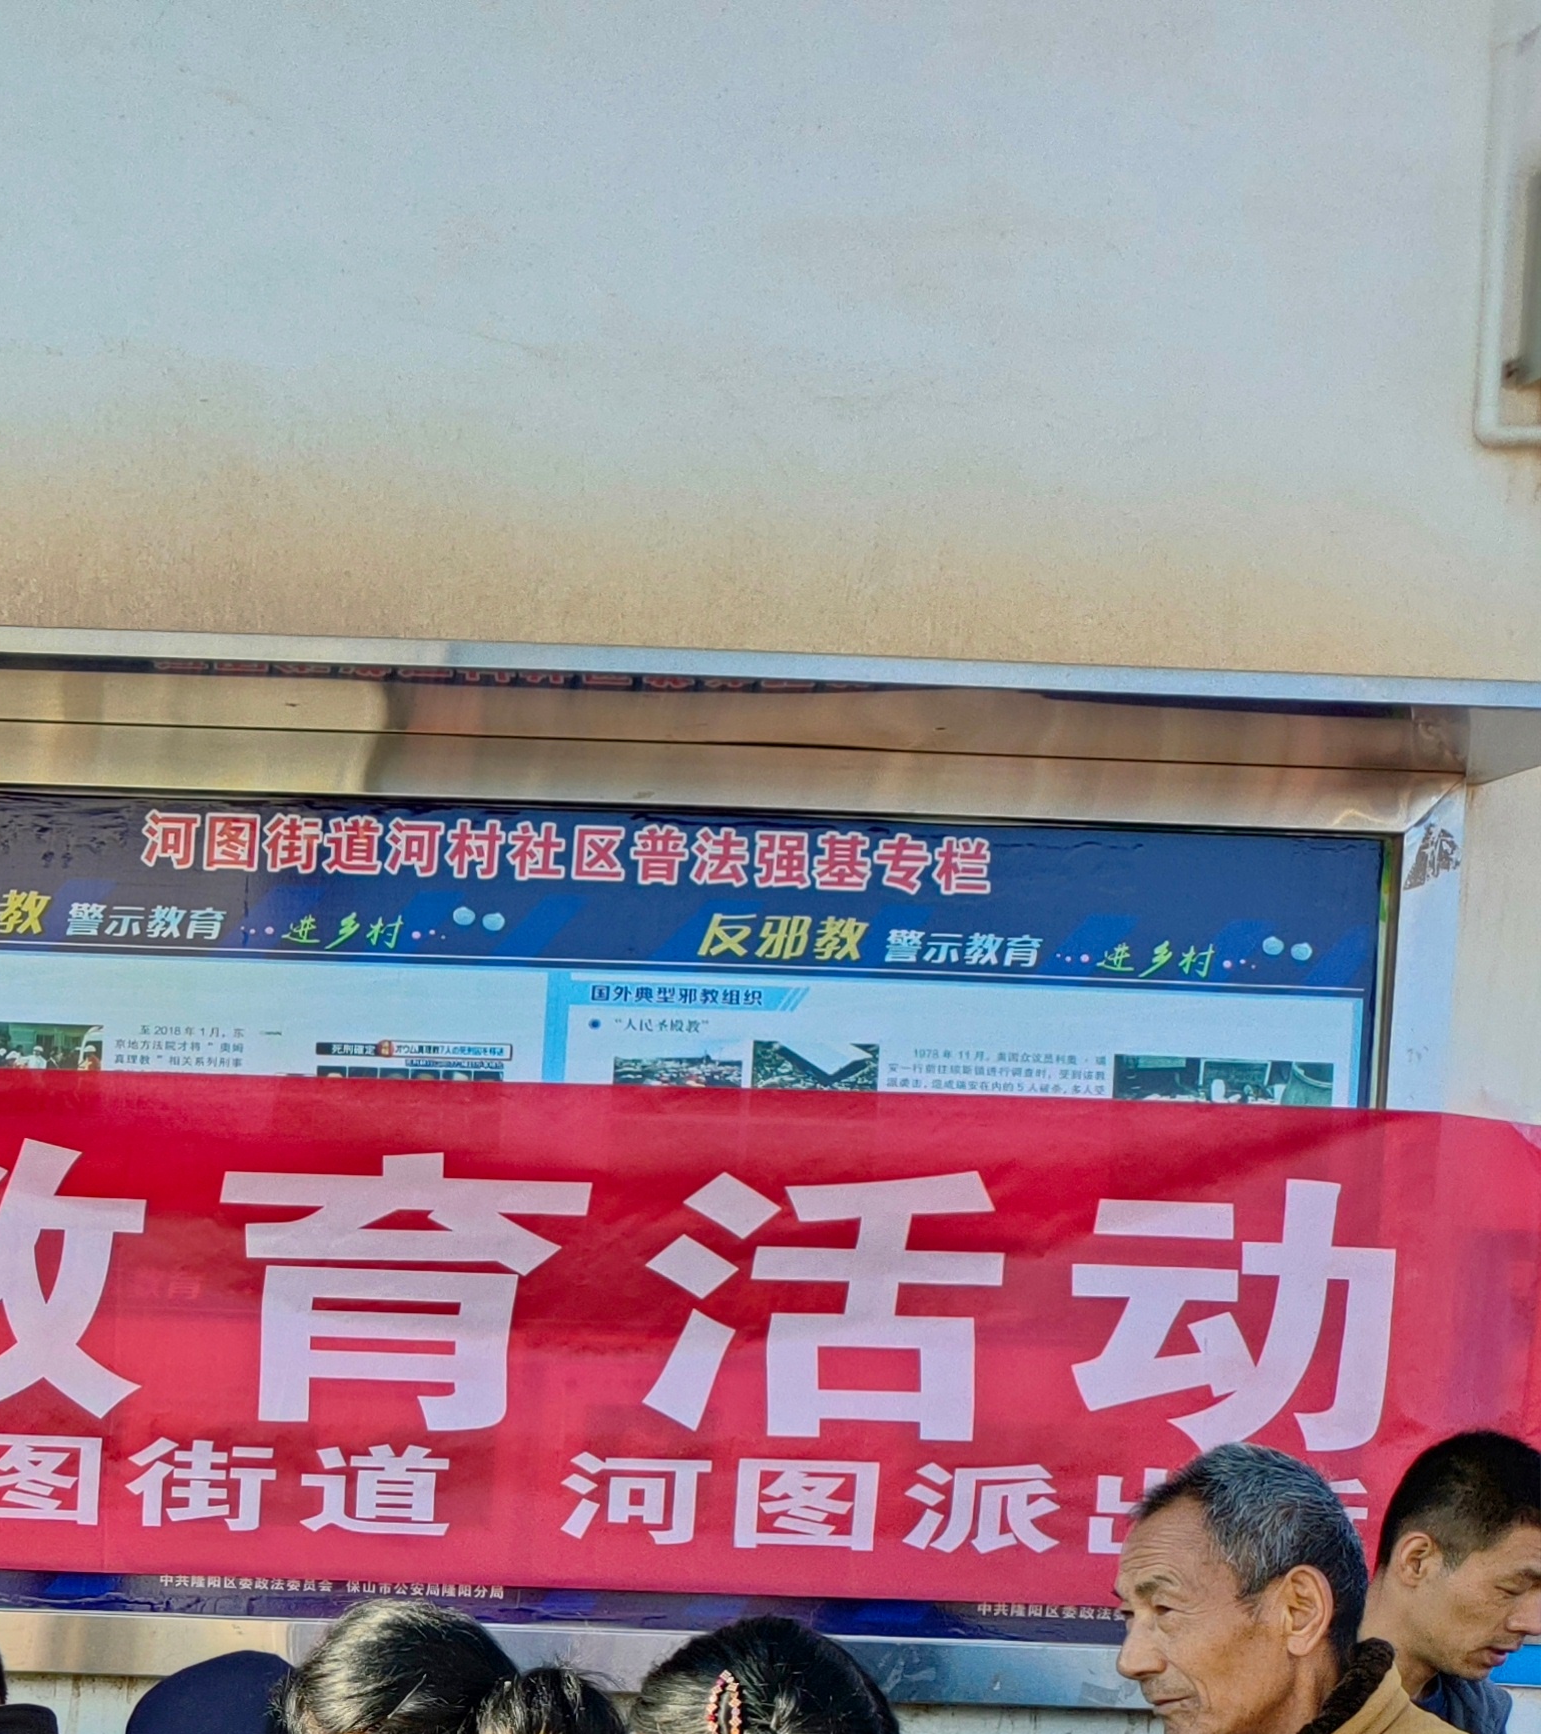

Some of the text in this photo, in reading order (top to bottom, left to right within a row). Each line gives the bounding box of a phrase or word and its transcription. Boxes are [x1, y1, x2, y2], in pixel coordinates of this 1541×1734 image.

[140, 808, 993, 897] 河图街道河村社区普法强基专栏
[66, 900, 229, 943] 警示教育
[695, 910, 868, 964] 反邪教
[883, 925, 1041, 970] 警示教育
[590, 984, 764, 1007] 国外典型邪教组织
[558, 1450, 1369, 1558] 河图派
[159, 1574, 505, 1600] 中共隆阳区委政法委员会 保山市公安局隆阳分局
